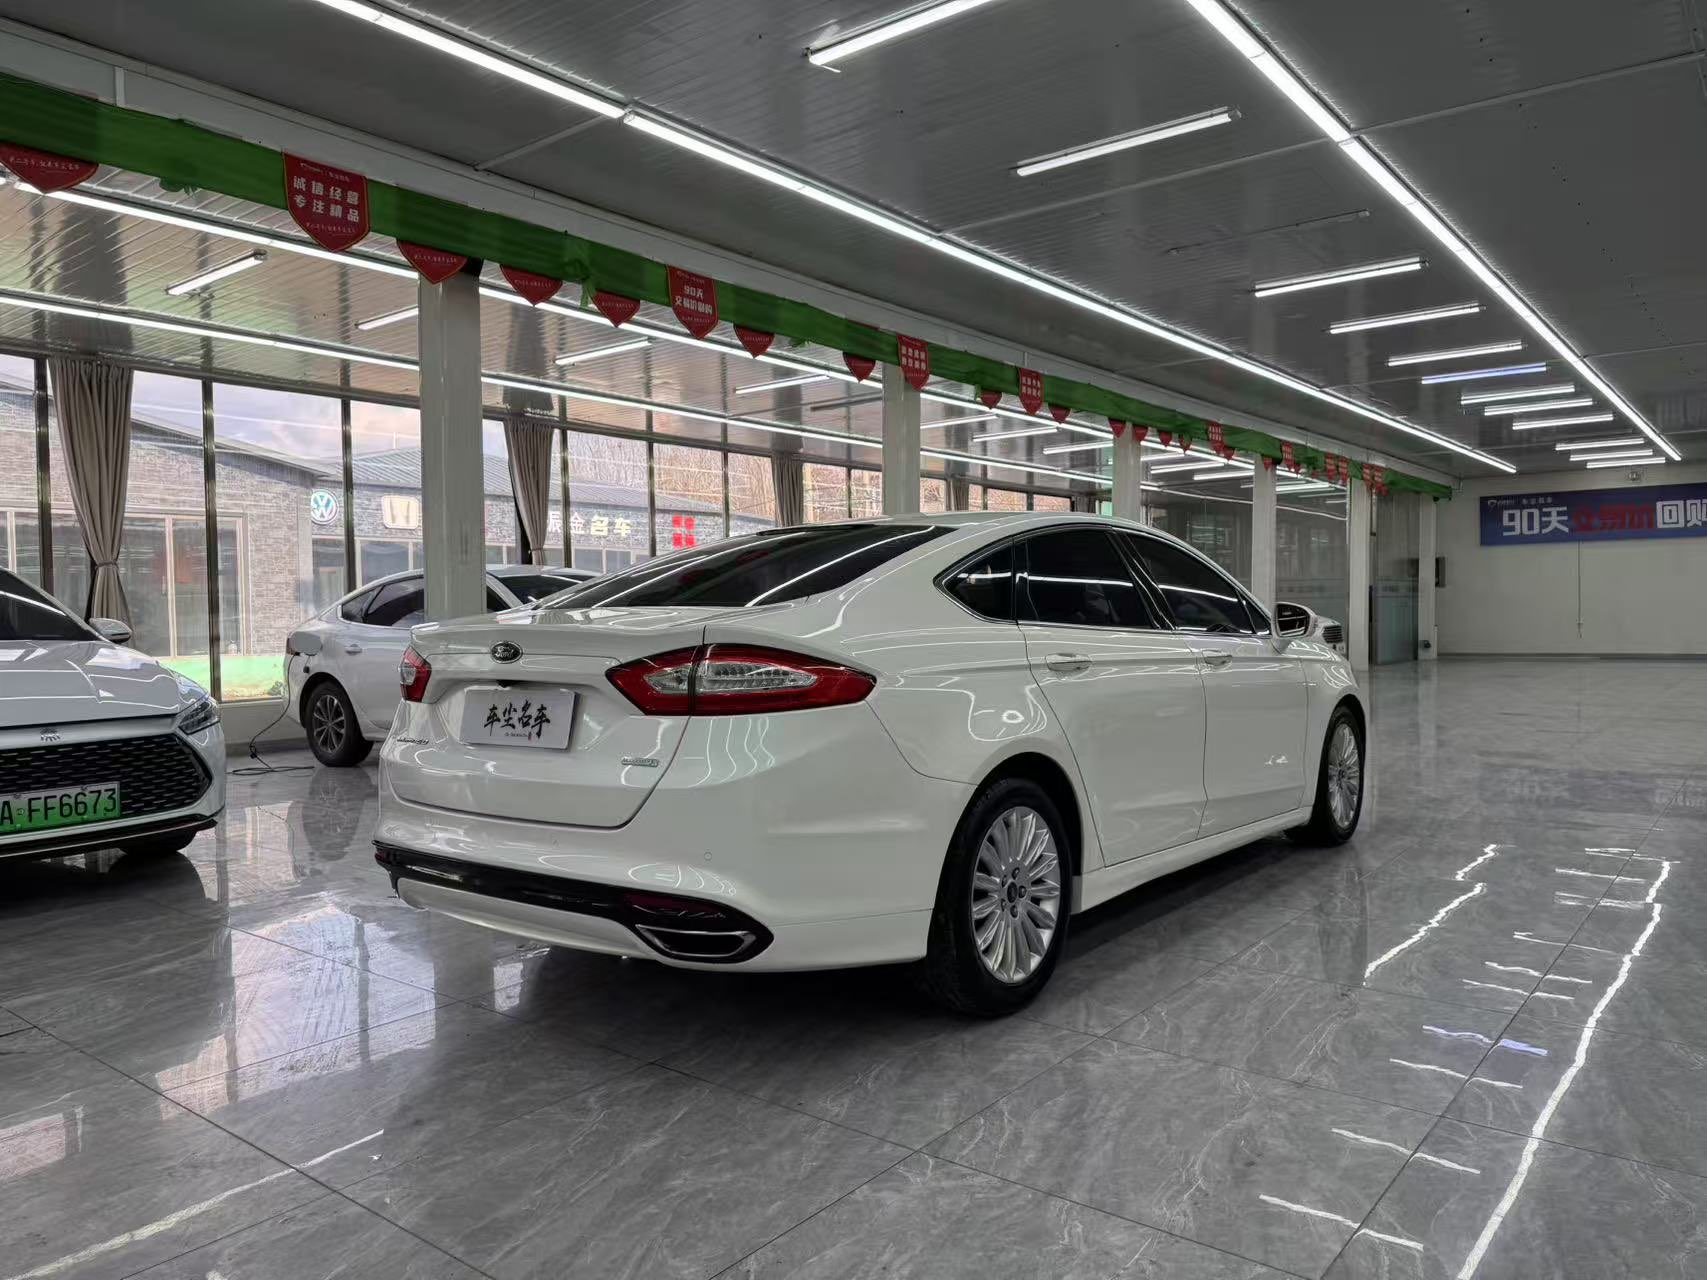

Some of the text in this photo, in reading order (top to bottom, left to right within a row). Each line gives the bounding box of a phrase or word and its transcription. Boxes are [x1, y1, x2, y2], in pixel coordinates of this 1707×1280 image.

[293, 176, 359, 206] 诚信经营
[294, 194, 359, 223] 专注精品
